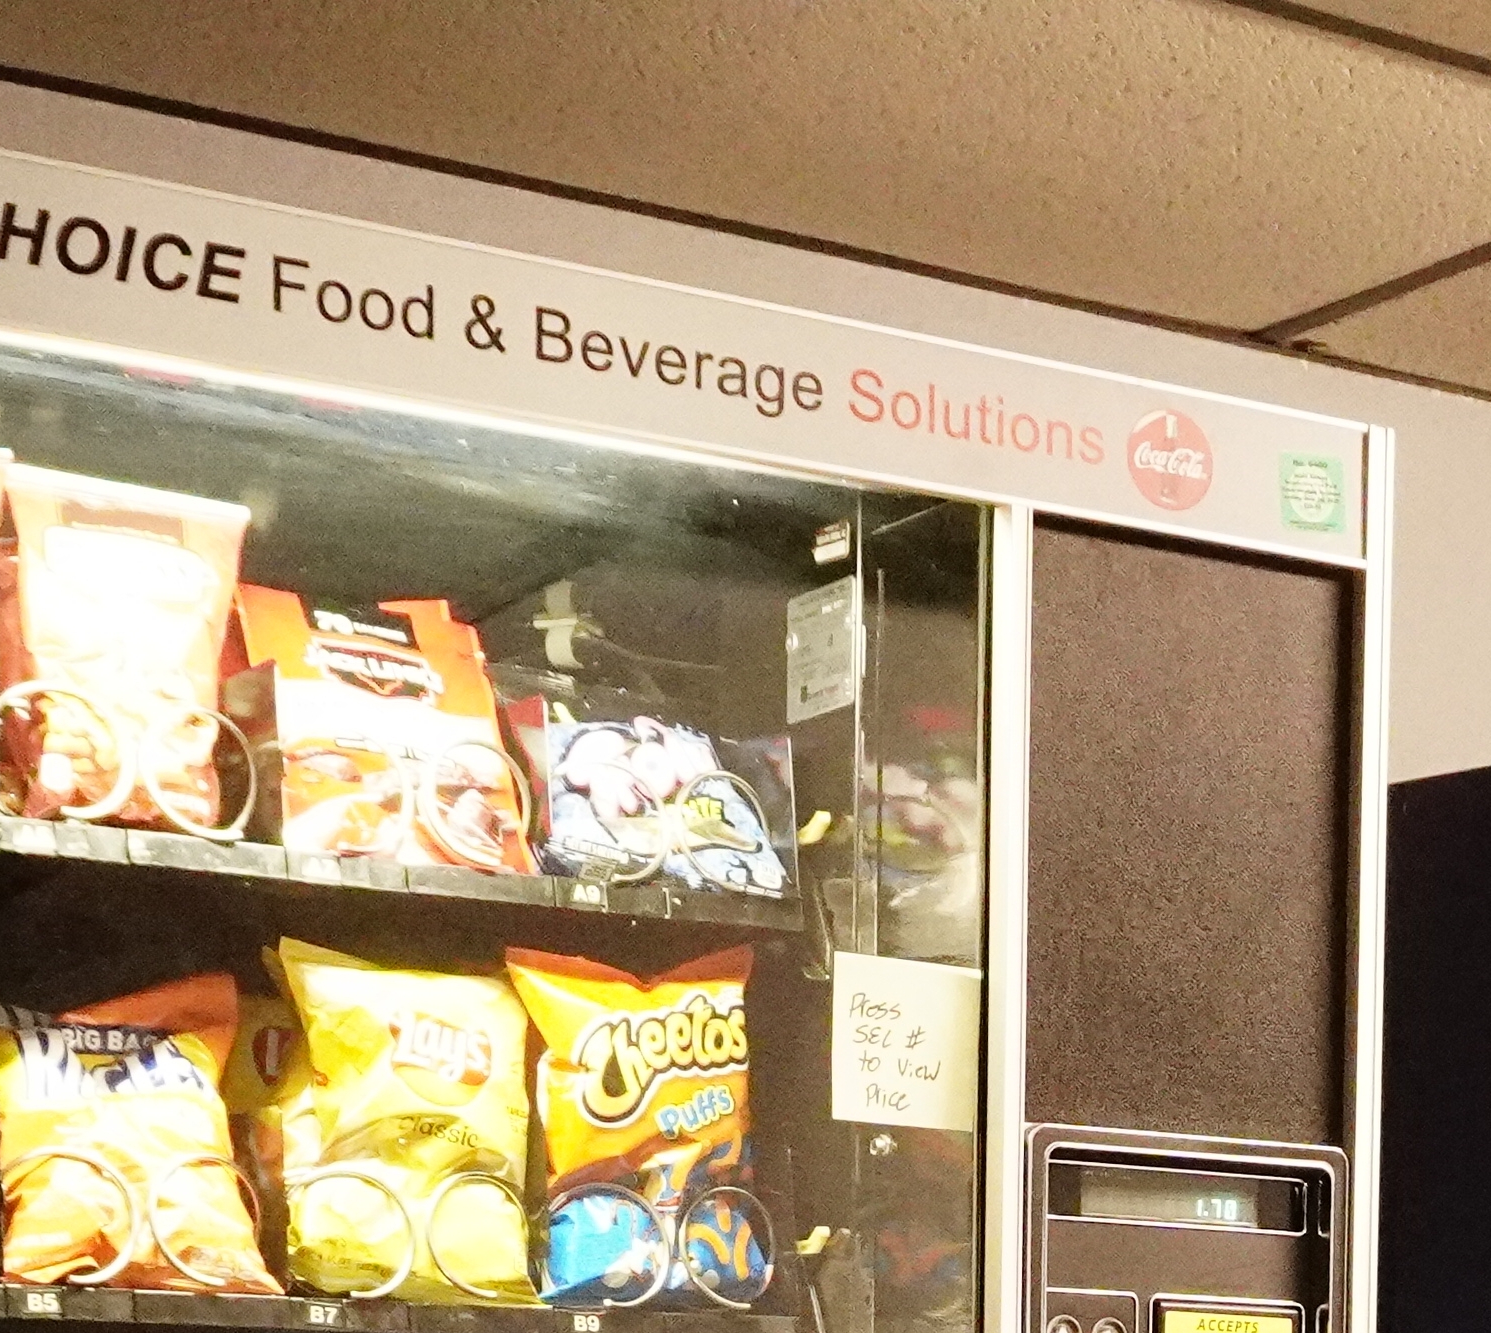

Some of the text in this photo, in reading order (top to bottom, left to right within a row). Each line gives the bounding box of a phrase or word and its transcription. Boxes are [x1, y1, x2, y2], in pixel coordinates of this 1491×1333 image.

[270, 255, 437, 342] Food
[464, 293, 507, 353] &
[535, 305, 826, 420] Beverage
[847, 368, 1107, 467] Solutions
[573, 884, 600, 903] A9
[906, 1026, 926, 1049] #
[580, 995, 749, 1122] Cheetos
[858, 1050, 881, 1073] to
[865, 1082, 912, 1111] Price
[27, 1293, 59, 1313] B5
[309, 1304, 338, 1325] B7
[573, 1314, 601, 1333] B9
